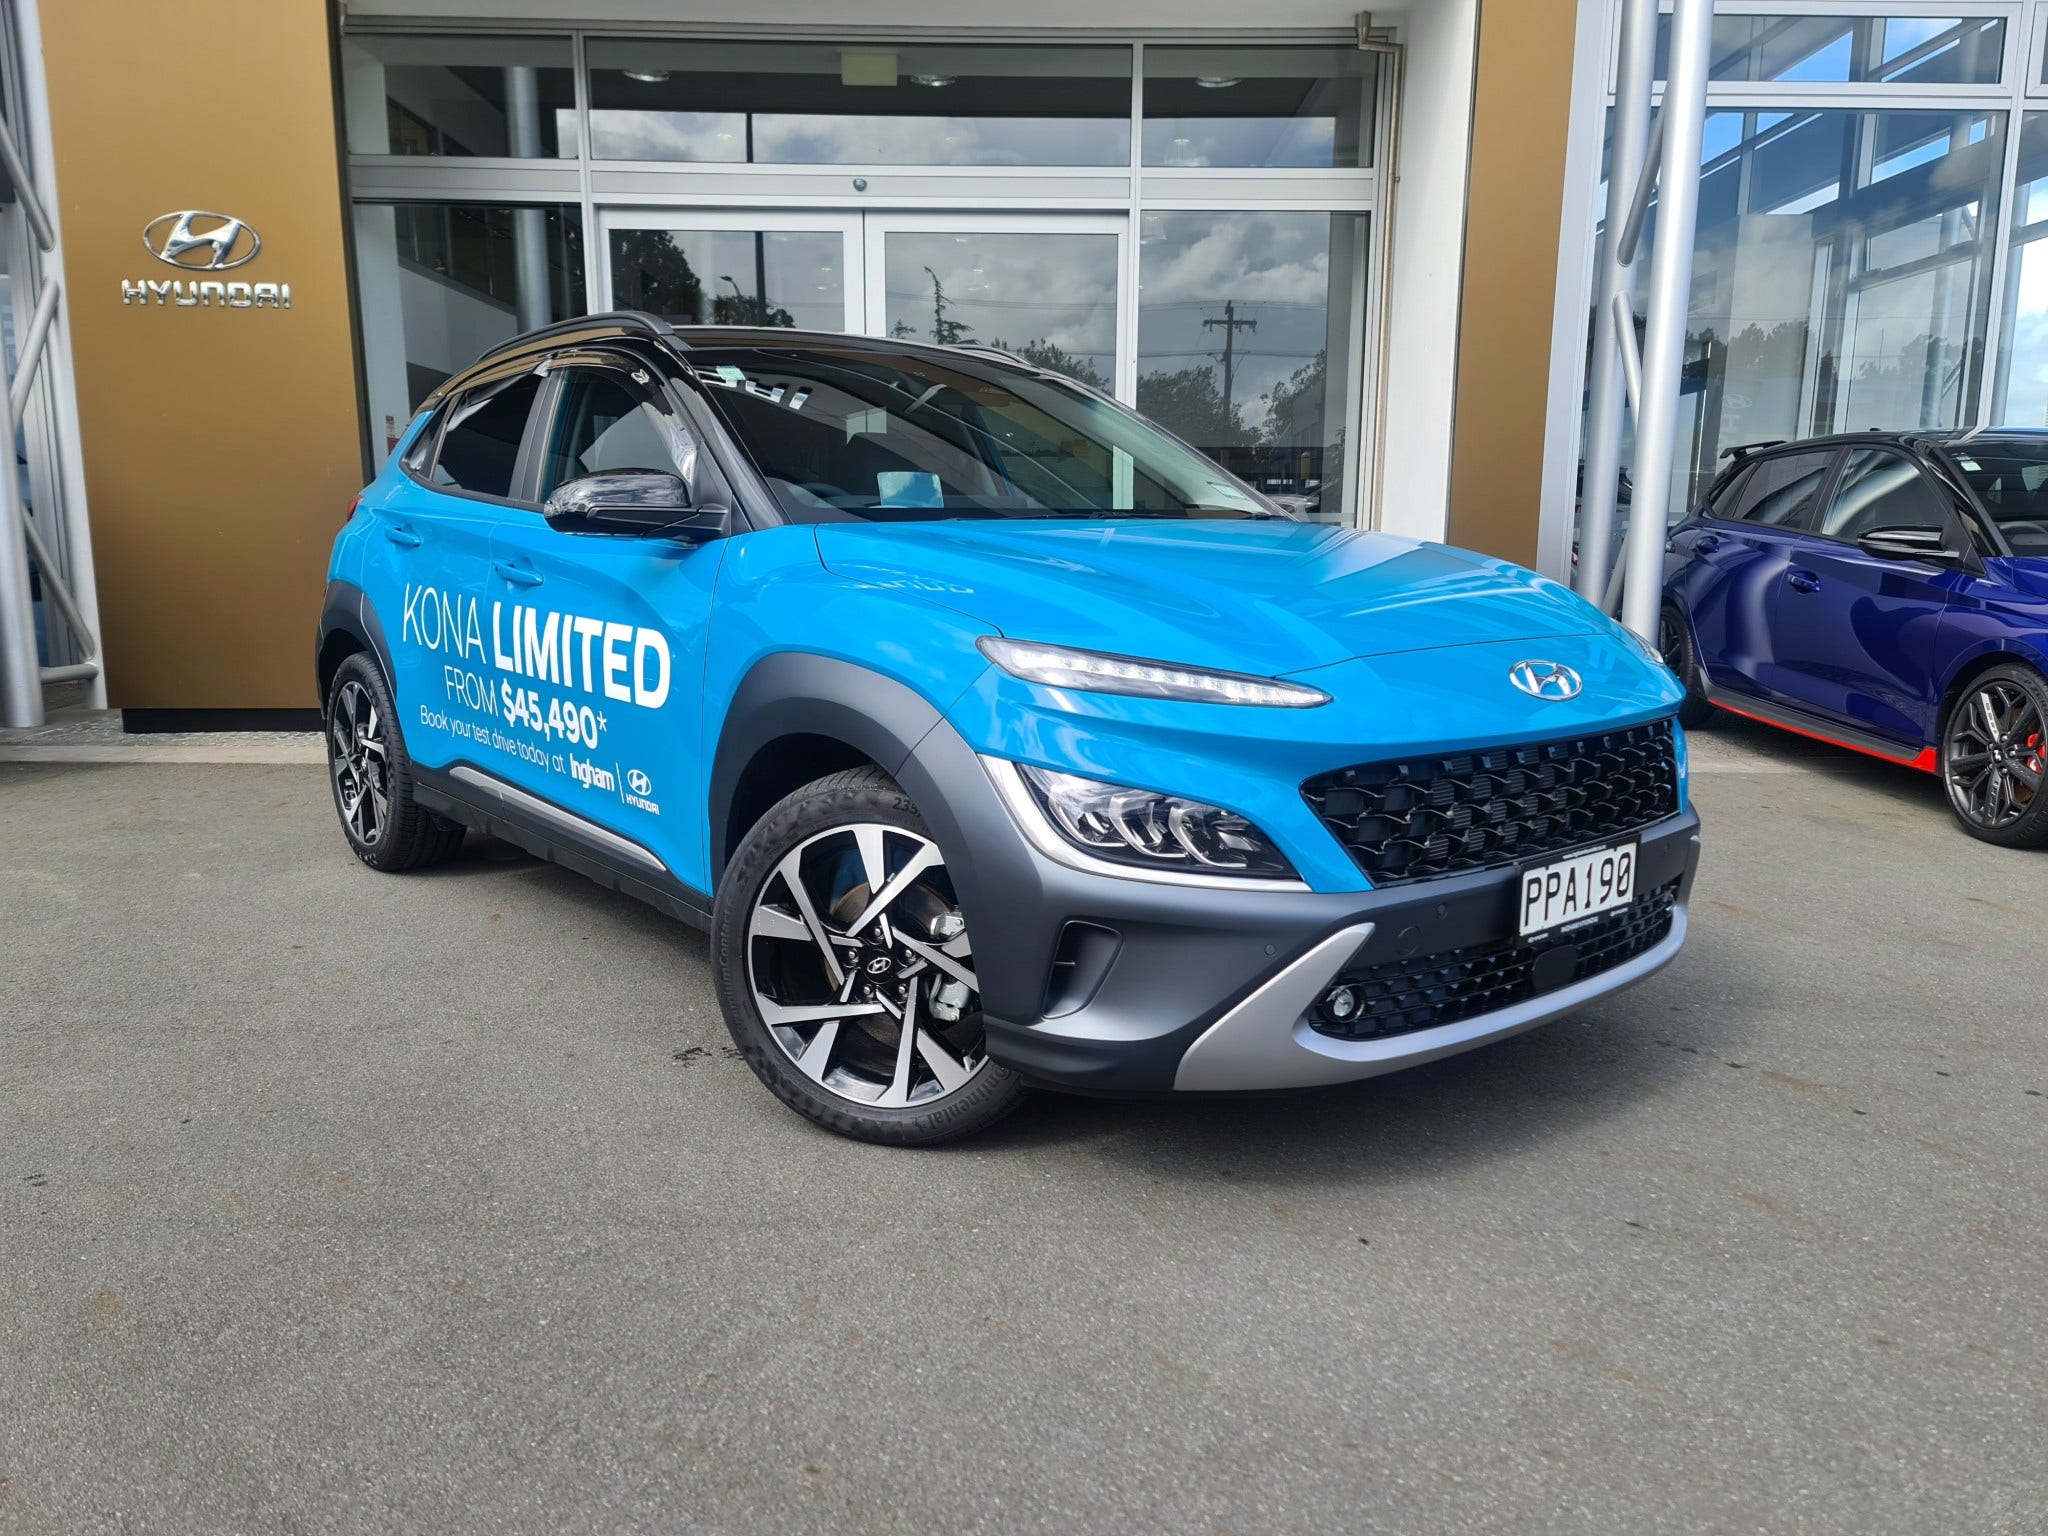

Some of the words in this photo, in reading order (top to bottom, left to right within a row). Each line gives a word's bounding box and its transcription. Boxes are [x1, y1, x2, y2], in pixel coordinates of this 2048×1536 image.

[121, 279, 291, 309] HYUNDAI
[403, 583, 486, 664] KONA
[493, 601, 671, 709] LIMITED
[444, 665, 498, 717] FROM
[420, 705, 448, 731] Book
[450, 718, 471, 738] your
[472, 723, 491, 746] test
[492, 729, 517, 756] drive
[517, 742, 549, 770] today
[552, 754, 566, 774] at
[570, 753, 615, 791] Ingham
[626, 793, 660, 815] HYUNDAI
[1525, 852, 1631, 927] PPA190
